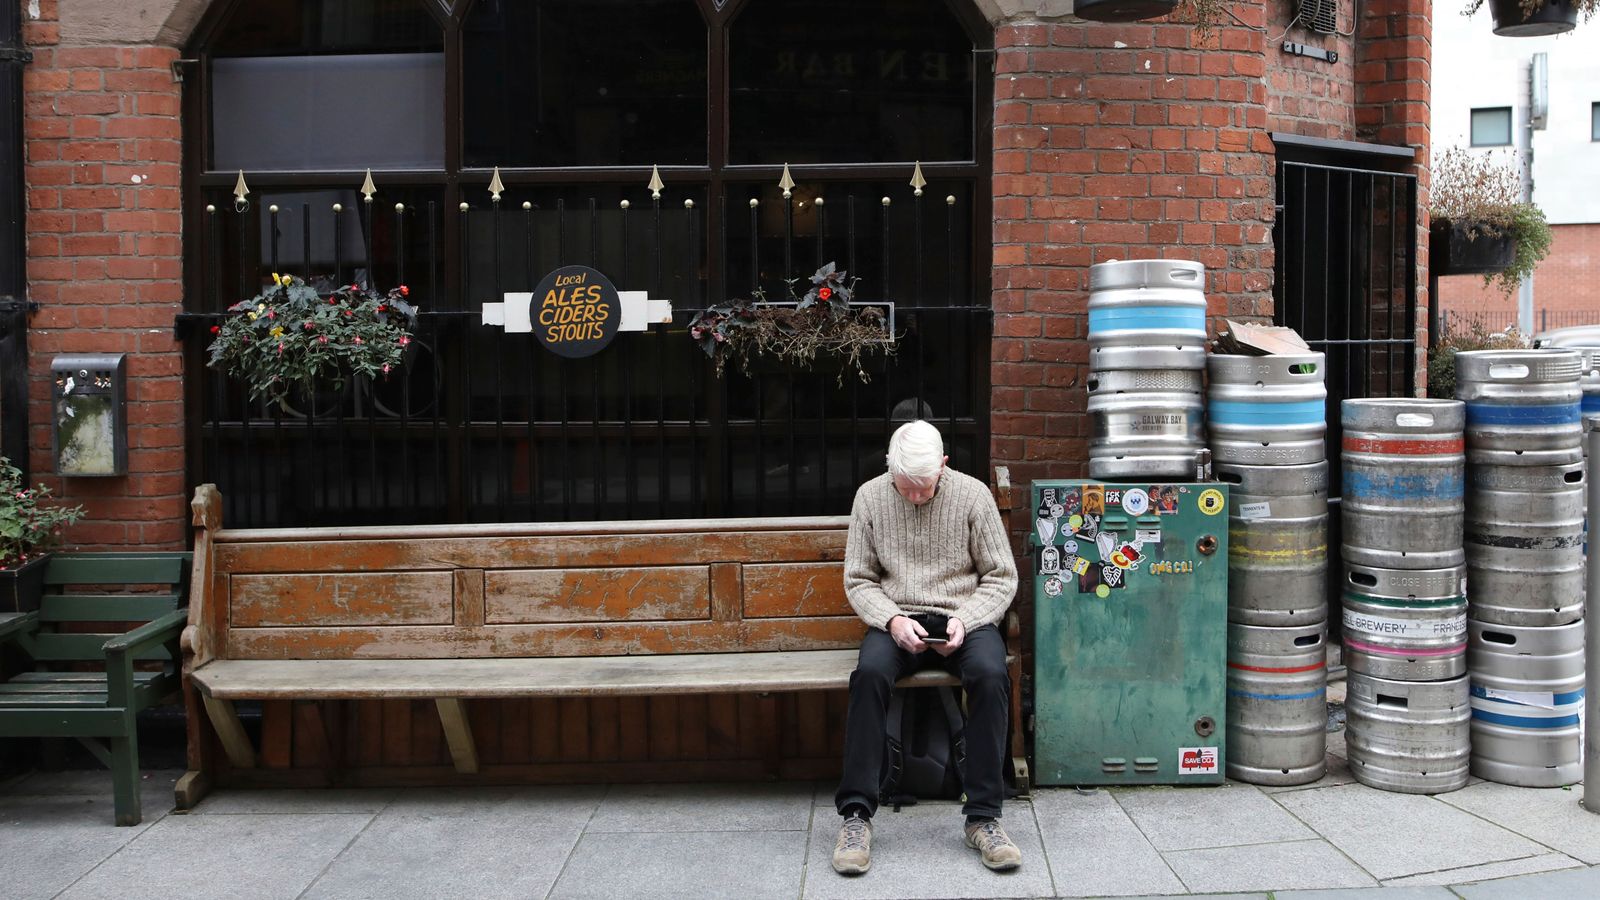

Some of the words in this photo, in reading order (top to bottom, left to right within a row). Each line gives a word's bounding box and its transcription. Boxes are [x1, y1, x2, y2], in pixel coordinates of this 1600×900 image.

[555, 272, 587, 287] Local
[542, 285, 602, 308] ALES
[539, 303, 609, 326] CIDERS
[546, 321, 604, 343] STOUTS
[1142, 415, 1169, 425] GALWAY
[1170, 415, 1182, 425] BAY
[1356, 617, 1407, 633] BREWERY
